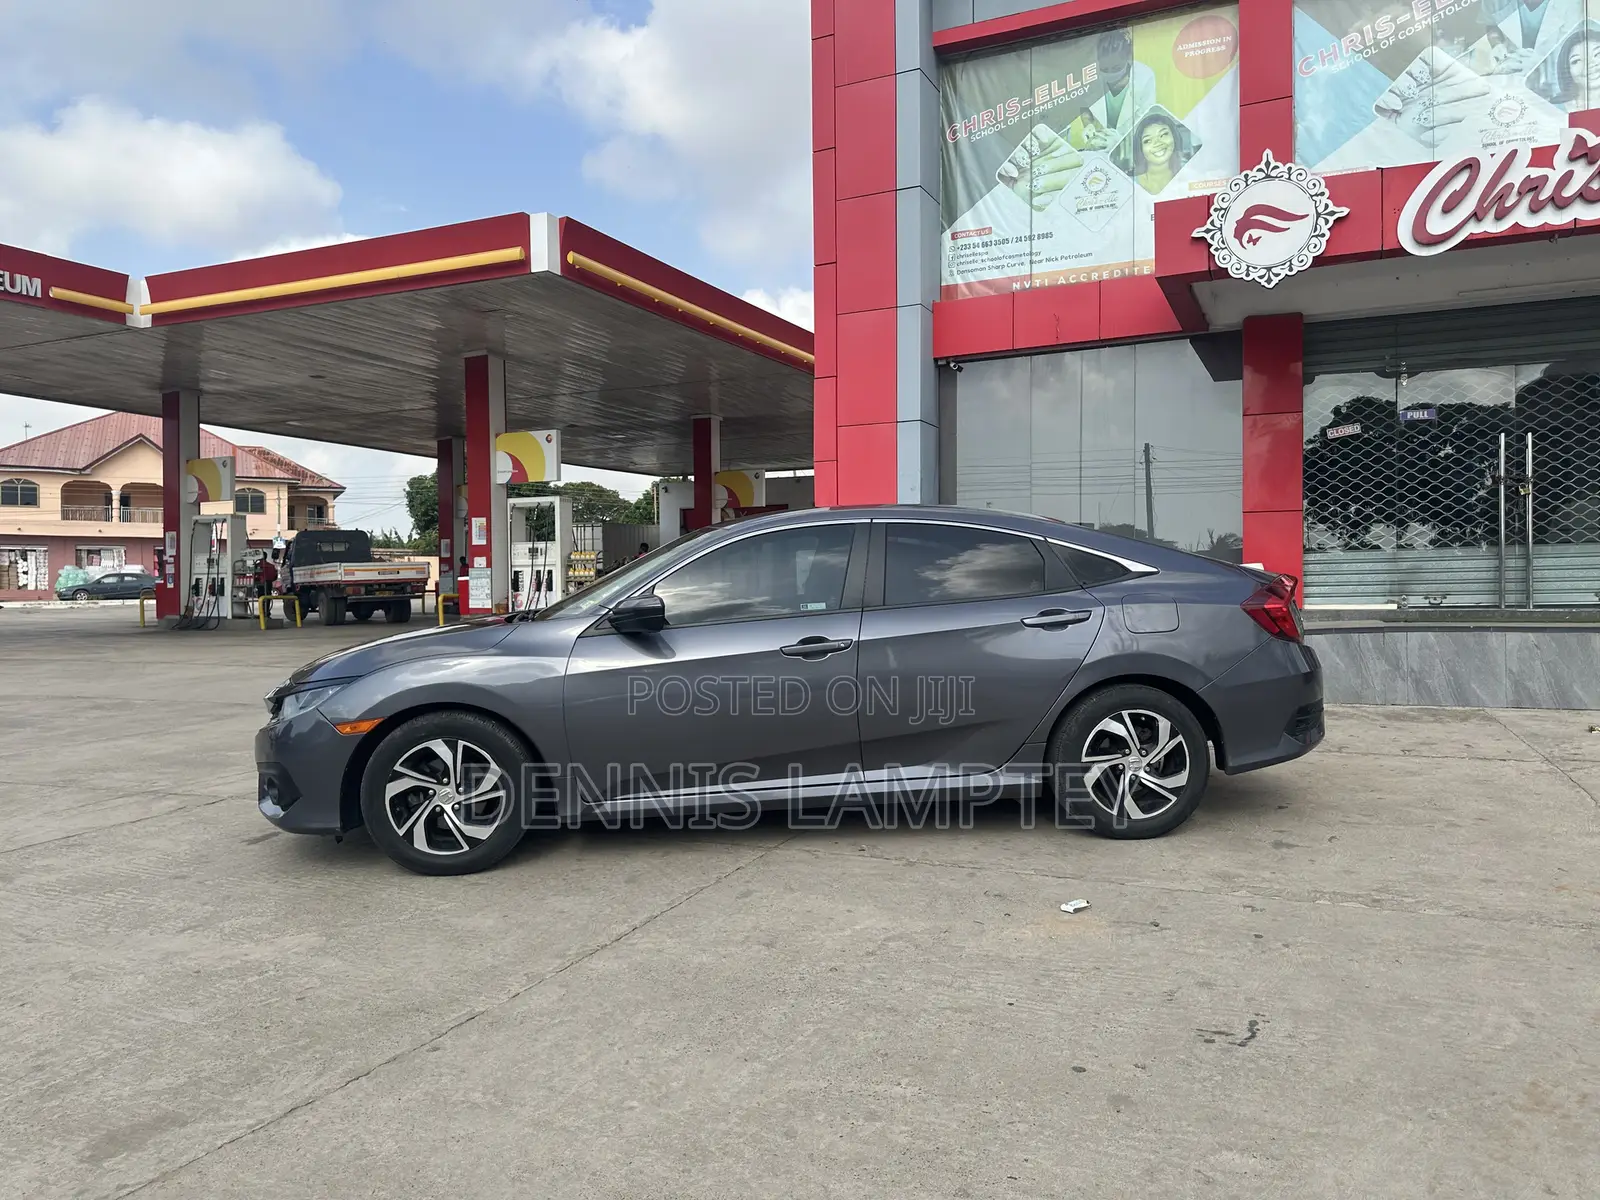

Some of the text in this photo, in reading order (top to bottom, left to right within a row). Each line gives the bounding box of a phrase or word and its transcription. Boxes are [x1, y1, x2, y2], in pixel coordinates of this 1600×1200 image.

[1177, 35, 1232, 51] ADMISSION IN
[1332, 0, 1479, 74] SCHOOL OF COSMETOLO
[1184, 45, 1226, 57] PROGRESS
[946, 62, 1098, 143] CHRIS-ELLE
[970, 85, 1090, 143] SCHOOL OF COSMETOLOGY
[954, 230, 980, 239] CONTACT
[957, 242, 971, 251] +233
[988, 263, 1006, 271] Sharp
[1045, 255, 1059, 263] Nick
[1060, 251, 1093, 261] Petroleum
[1012, 278, 1049, 291] NVTI
[1407, 410, 1429, 419] PULL
[1327, 424, 1360, 437] CLOSED
